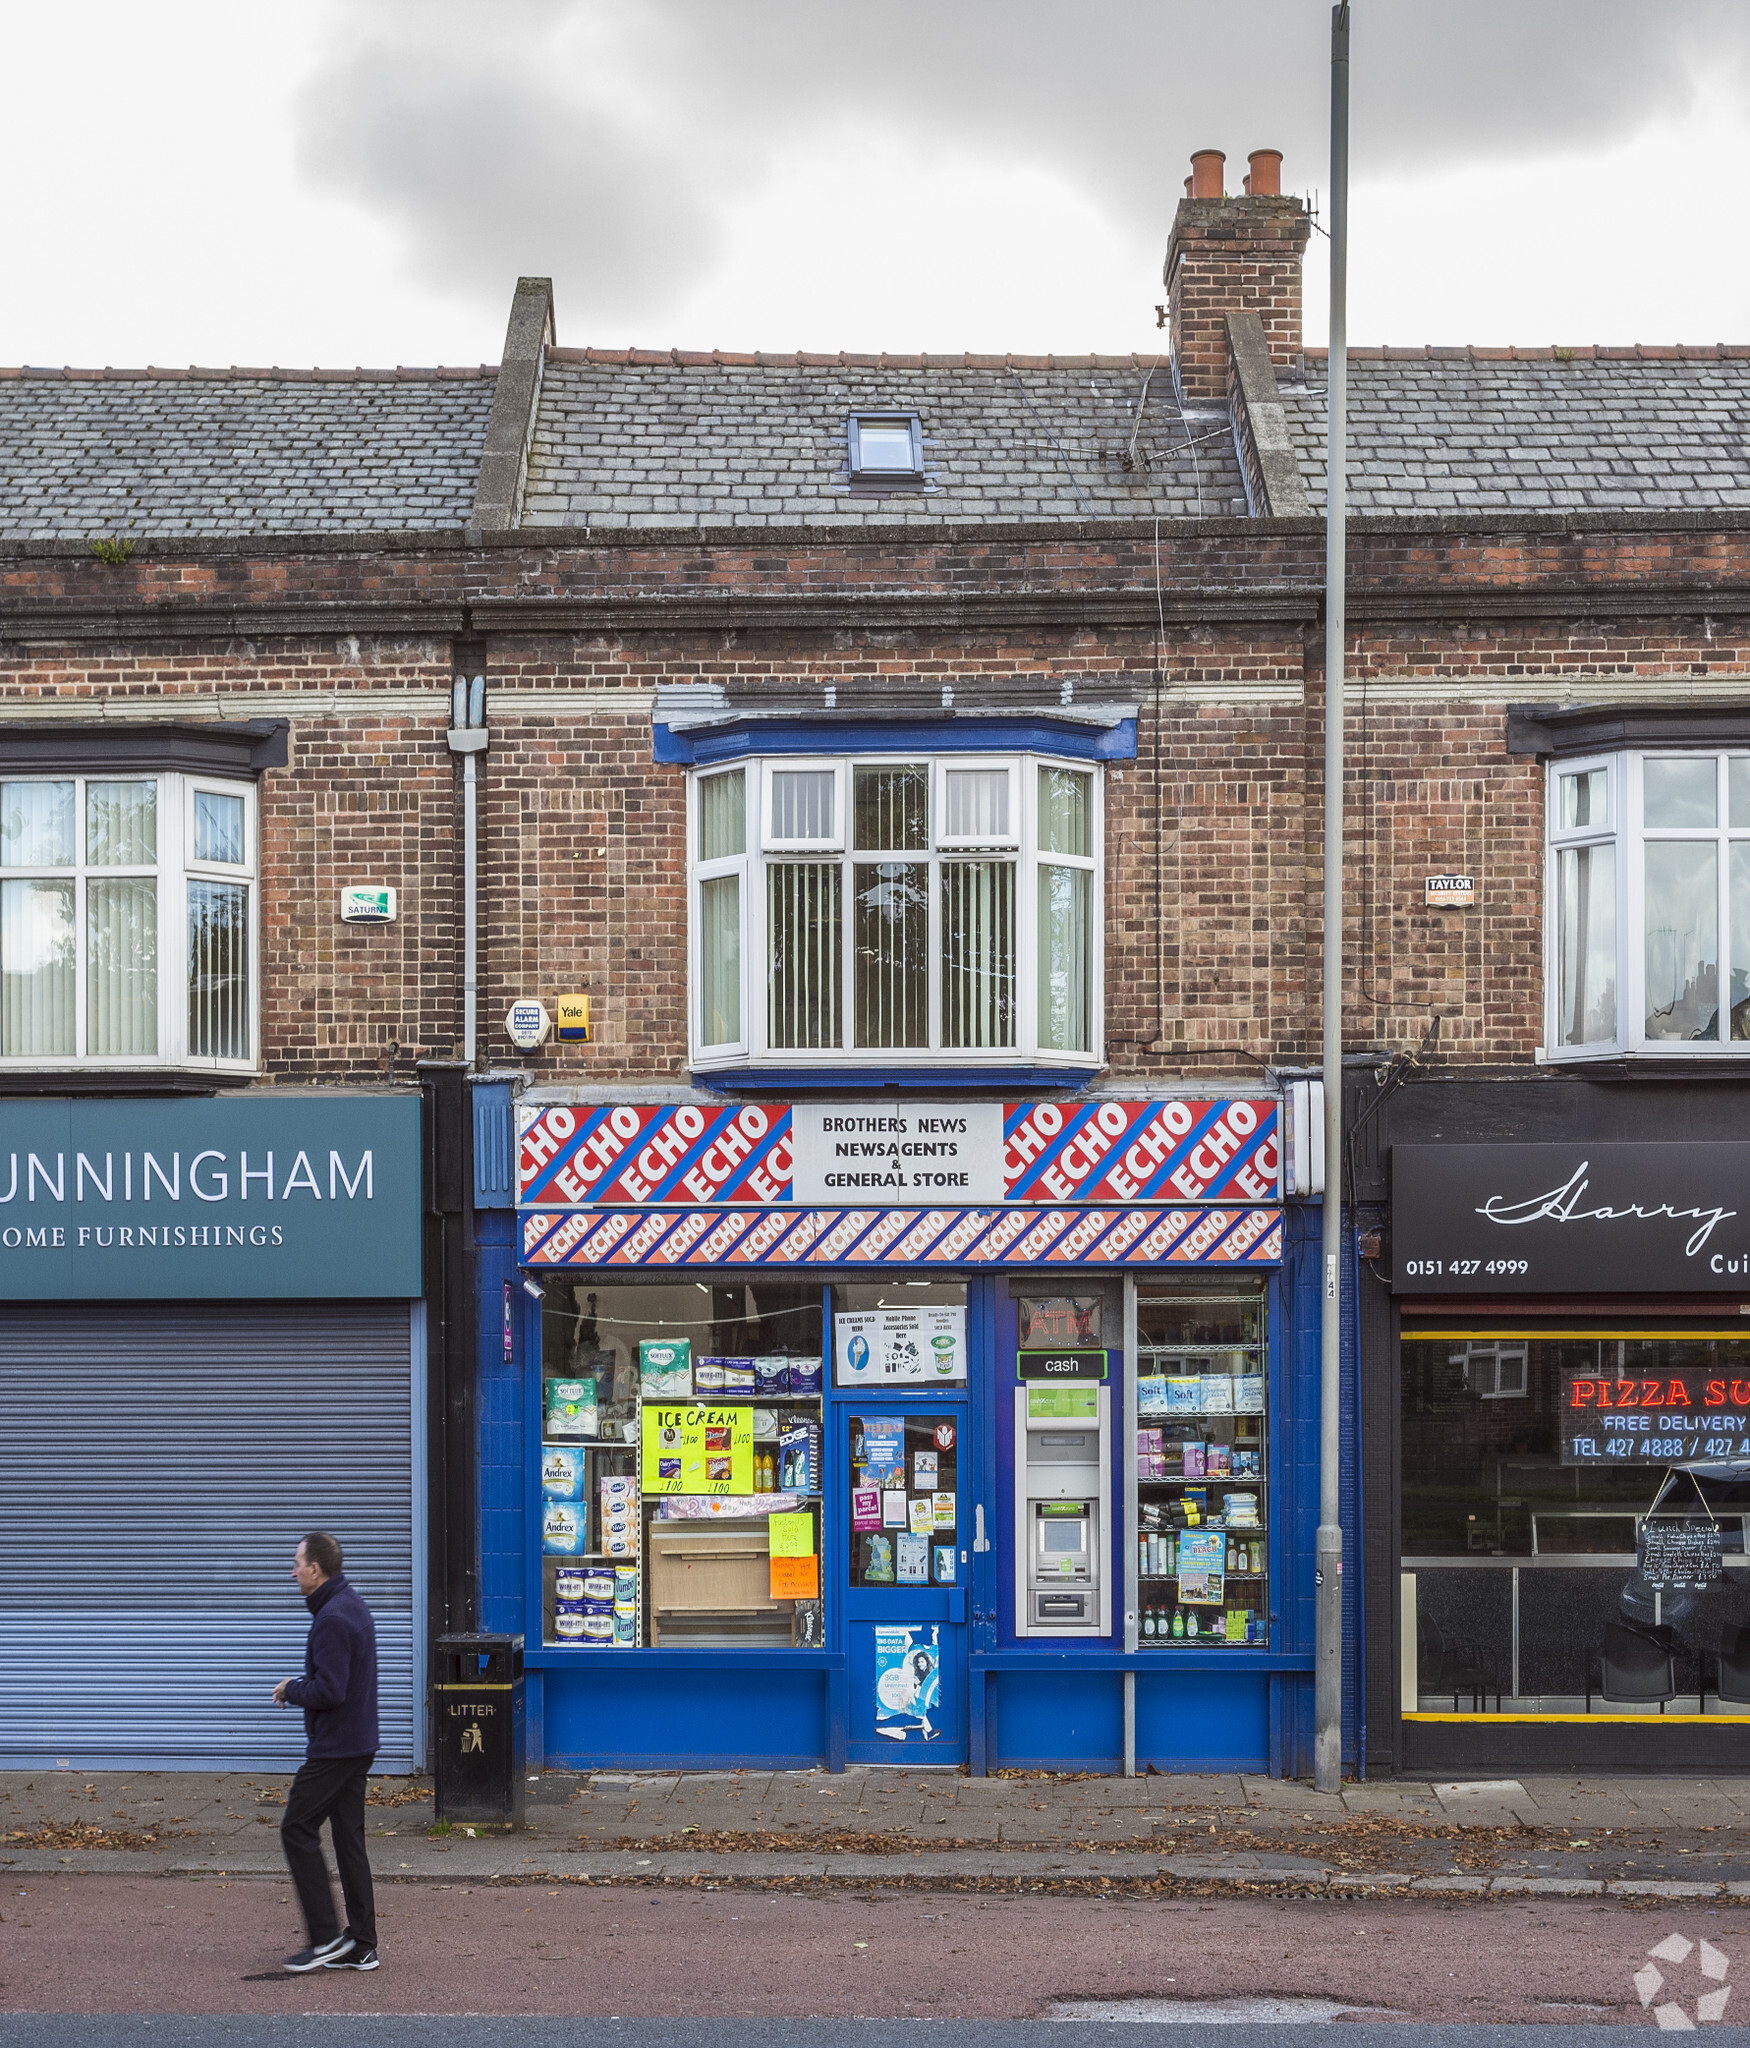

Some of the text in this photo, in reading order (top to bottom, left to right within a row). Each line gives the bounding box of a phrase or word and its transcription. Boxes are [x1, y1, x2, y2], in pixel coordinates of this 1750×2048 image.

[1430, 880, 1471, 890] TAYLOR
[561, 1007, 582, 1017] Yale
[823, 1118, 967, 1133] BROTHERS NEWS
[554, 1106, 640, 1202] ECHO
[618, 1106, 704, 1202] ECHO
[682, 1105, 768, 1202] ECHO
[835, 1142, 957, 1156] NEWSAGENTS
[1040, 1102, 1127, 1200] ECHO
[1105, 1102, 1192, 1199] ECHO
[1170, 1101, 1257, 1199] ECHO
[891, 1159, 902, 1169] &
[824, 1173, 969, 1187] GENERAL STORE
[1475, 1160, 1737, 1256] Harry
[2, 1225, 284, 1248] OME FURNISHINGS
[542, 1214, 588, 1263] ECHO
[581, 1214, 628, 1263] ECHO
[622, 1214, 666, 1263] ECHO
[660, 1213, 706, 1263] ECHO
[700, 1213, 745, 1262] ECHO
[739, 1212, 786, 1262] ECHO
[779, 1211, 825, 1261] ECHO
[819, 1211, 865, 1261] ECHO
[860, 1211, 906, 1260] ECHO
[900, 1211, 945, 1261] ECHO
[938, 1211, 985, 1261] ECHO
[980, 1211, 1026, 1261] ECHO
[1018, 1211, 1066, 1260] ECHO
[1059, 1211, 1105, 1261] ECHO
[1100, 1211, 1147, 1261] ECHO
[1140, 1211, 1187, 1260] ECHO
[1180, 1210, 1227, 1260] ECHO
[1221, 1210, 1268, 1260] ECHO
[1406, 1260, 1529, 1275] 0151 427 4999
[1710, 1254, 1748, 1274] Cui
[1027, 1310, 1091, 1335] ATM
[1045, 1357, 1078, 1372] cash
[1142, 1386, 1160, 1395] Soft
[1174, 1390, 1193, 1399] Soft
[1571, 1380, 1691, 1407] PIZZA
[658, 1411, 737, 1427] ICE CREAM
[1602, 1416, 1746, 1431] FREE DELIVERY
[780, 1427, 808, 1447] EDGE
[1573, 1438, 1601, 1457] TEL
[1605, 1438, 1634, 1457] 427
[1640, 1438, 1683, 1457] 4888
[1705, 1438, 1733, 1457] 427
[544, 1468, 572, 1477] Andrex
[858, 1505, 878, 1513] parcel
[859, 1494, 873, 1502] pass
[545, 1522, 574, 1532] Andrex
[1649, 1521, 1680, 1532] Lunch
[616, 1576, 634, 1593] Jumbo
[618, 1615, 635, 1632] Jumbo
[877, 1646, 906, 1654] BIGGER
[450, 1704, 494, 1716] LITTER
